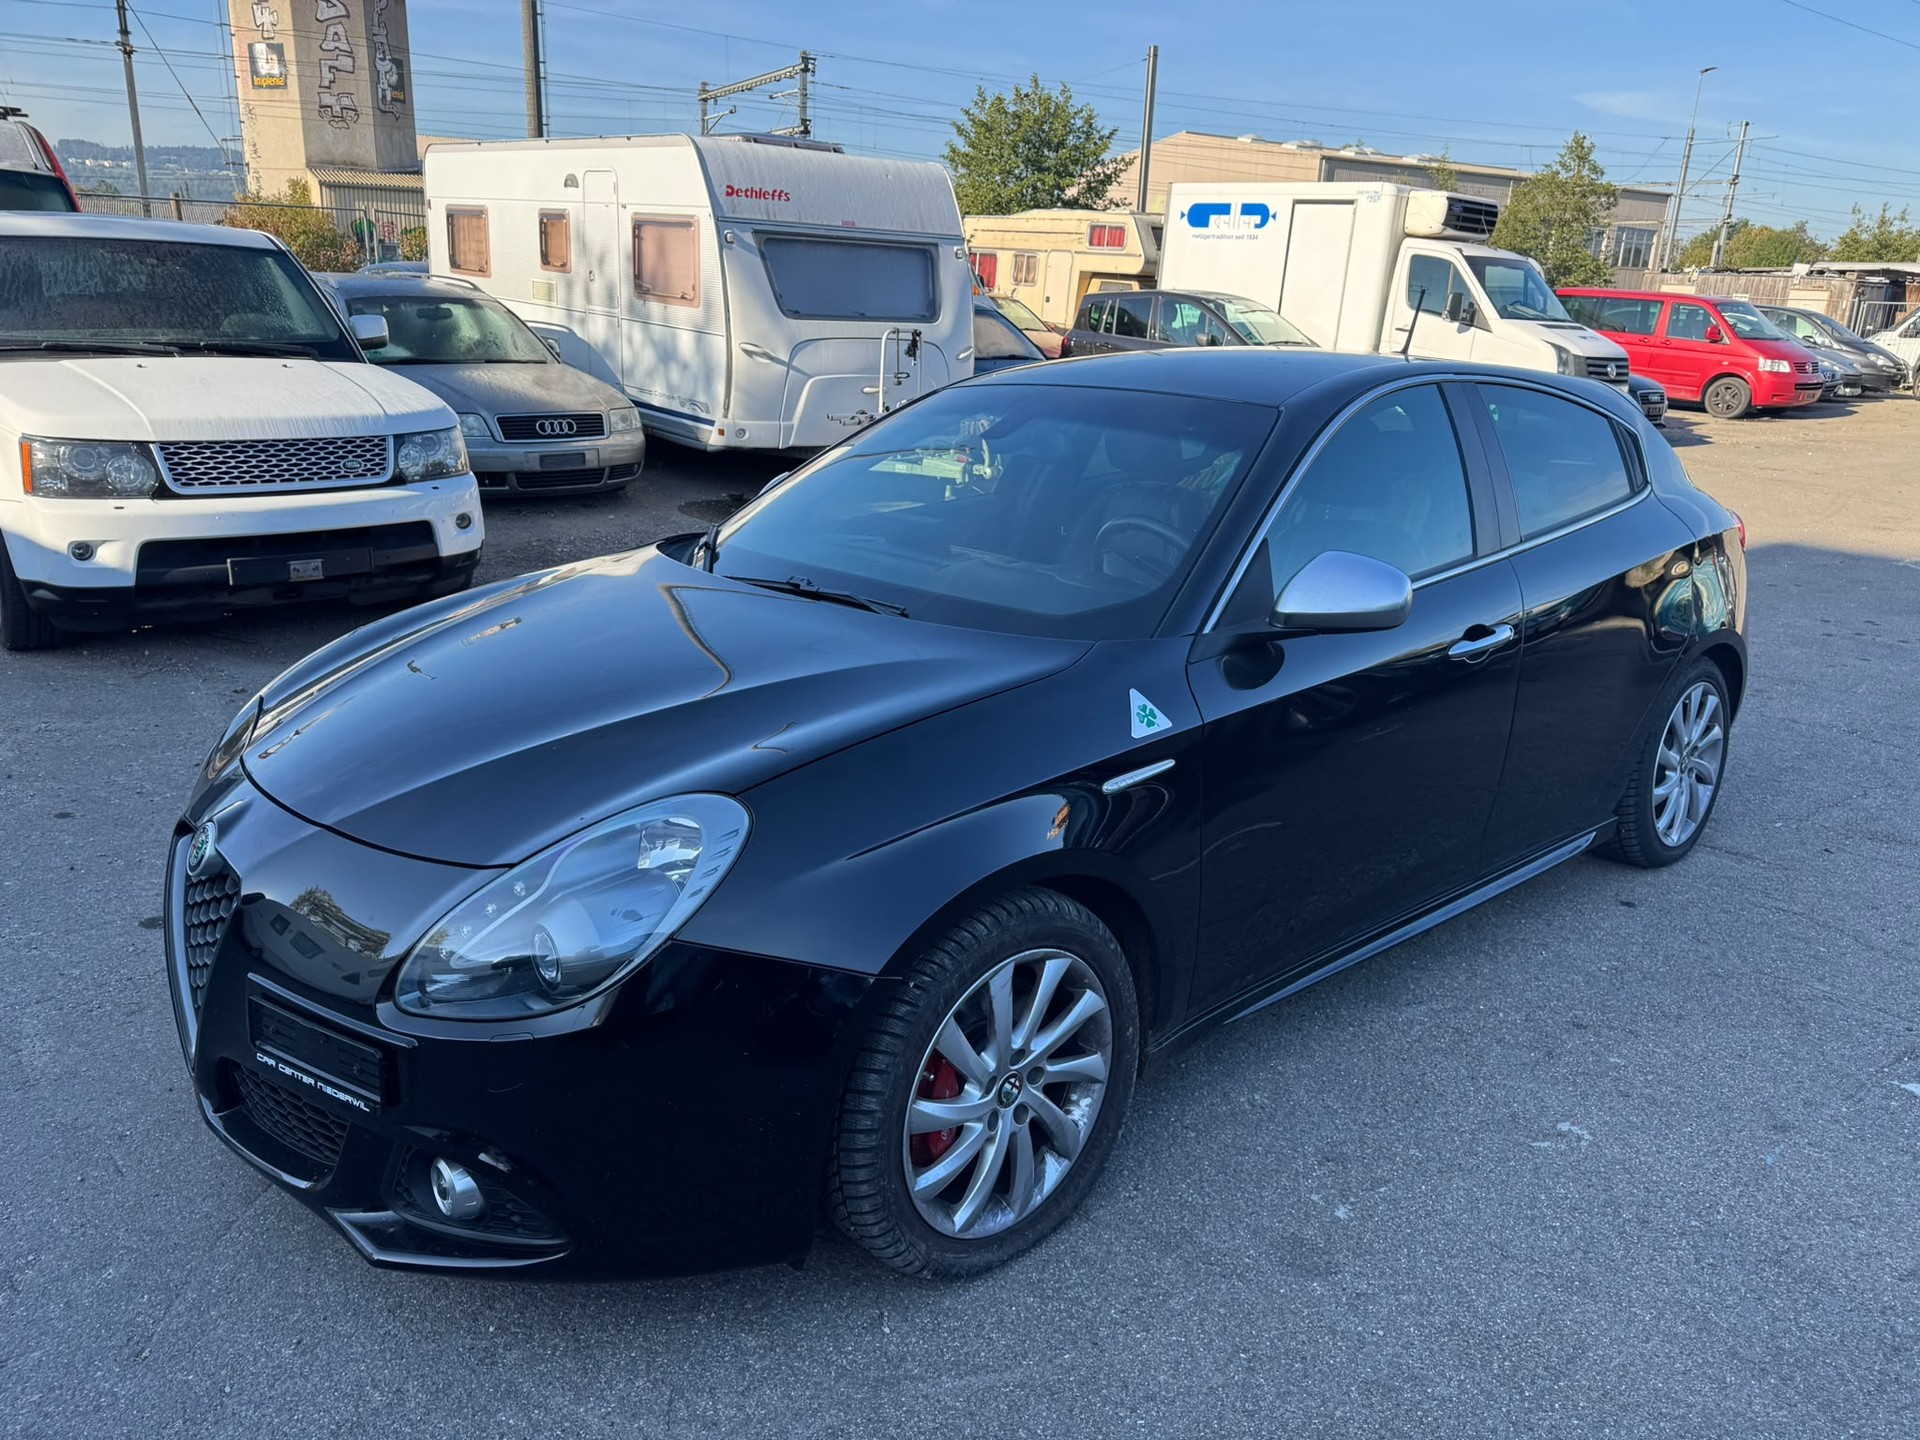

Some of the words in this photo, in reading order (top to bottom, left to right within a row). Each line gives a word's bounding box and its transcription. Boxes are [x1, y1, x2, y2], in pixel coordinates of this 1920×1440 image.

[253, 75, 285, 88] Implenia
[724, 184, 791, 202] Dethleffs
[256, 1052, 276, 1068] CAR
[278, 1063, 315, 1087] CENTER
[317, 1081, 370, 1112] NIEDERWIL
